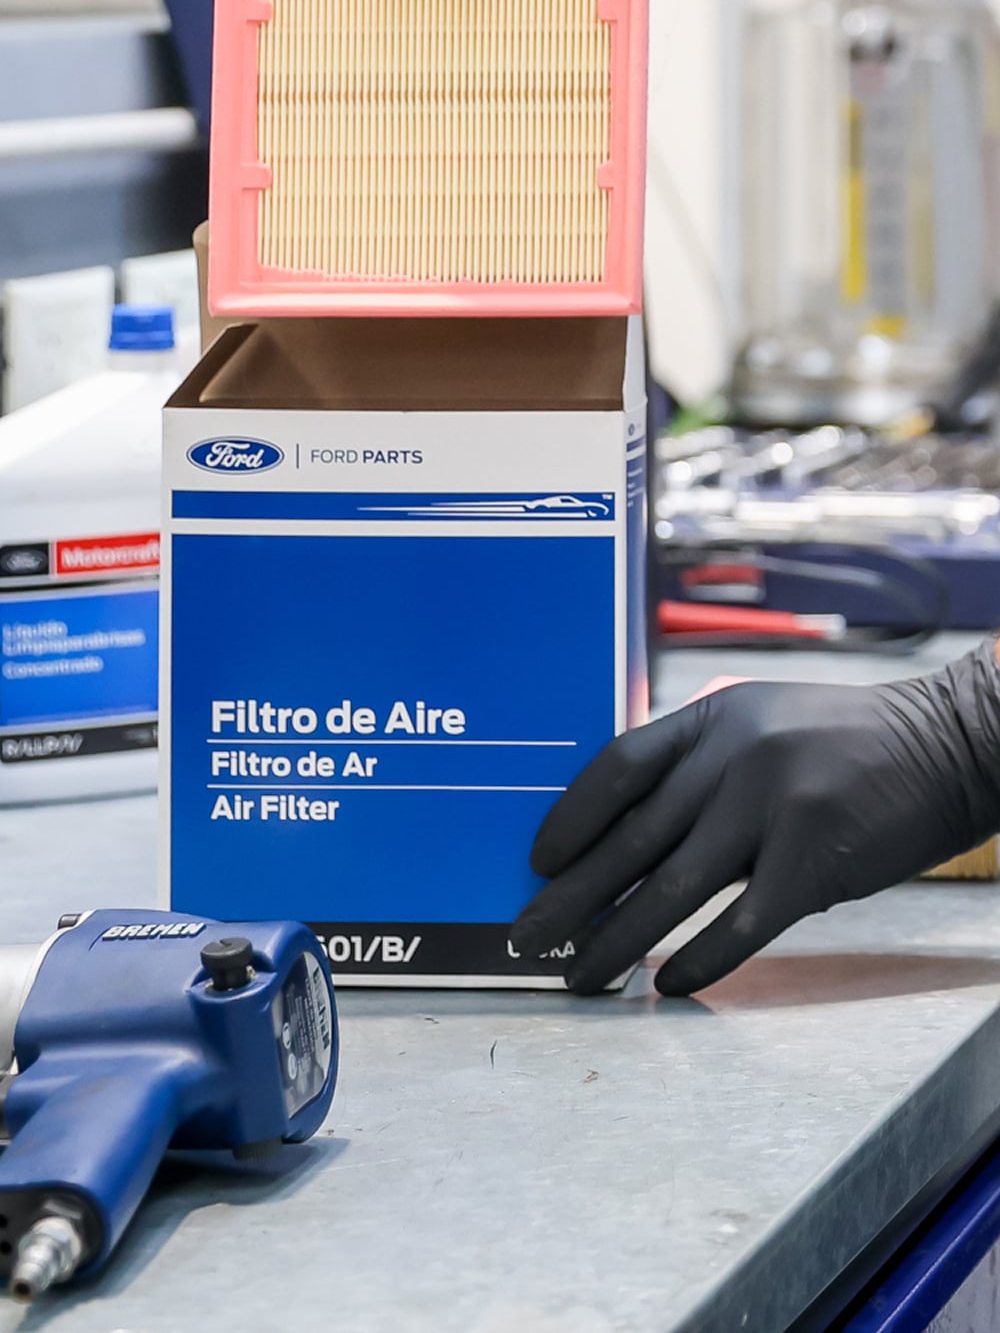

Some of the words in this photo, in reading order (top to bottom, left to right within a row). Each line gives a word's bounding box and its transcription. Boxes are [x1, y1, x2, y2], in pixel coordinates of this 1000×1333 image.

[205, 441, 264, 468] Ford
[310, 449, 358, 464] FORD
[362, 449, 423, 465] PARTS
[211, 699, 318, 735] Filtro
[325, 700, 377, 735] de
[384, 700, 466, 736] Aire
[211, 751, 292, 778] Filtro
[297, 751, 335, 777] de
[342, 752, 378, 777] Ar
[210, 794, 254, 821] Air
[260, 795, 340, 821] Filter
[102, 922, 206, 941] BREMEN
